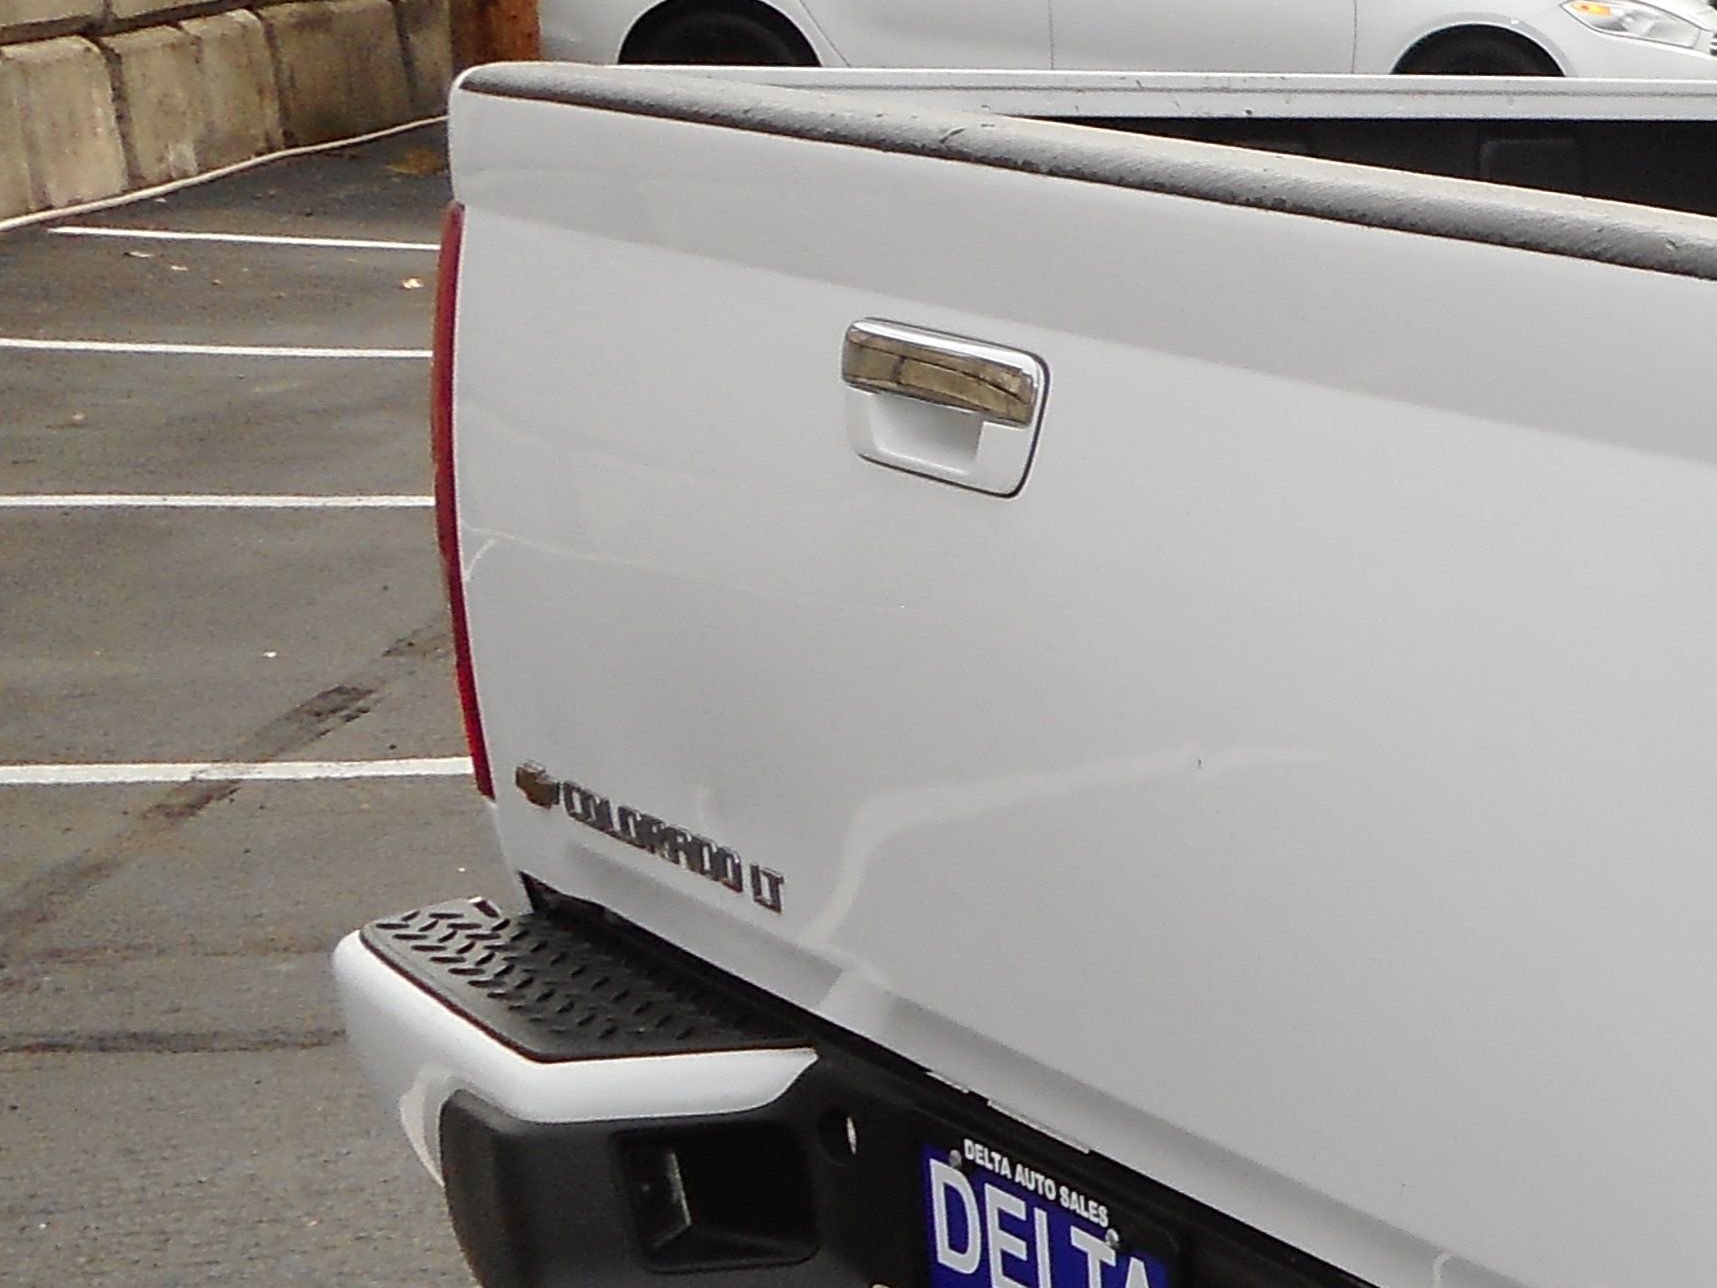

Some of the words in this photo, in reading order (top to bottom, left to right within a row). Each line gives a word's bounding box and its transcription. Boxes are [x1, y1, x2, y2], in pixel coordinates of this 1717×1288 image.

[562, 779, 743, 893] COLORADO
[750, 863, 785, 914] LT
[964, 1138, 1011, 1180] DELTA
[1014, 1162, 1056, 1201] AUTO
[1060, 1185, 1109, 1228] SALES
